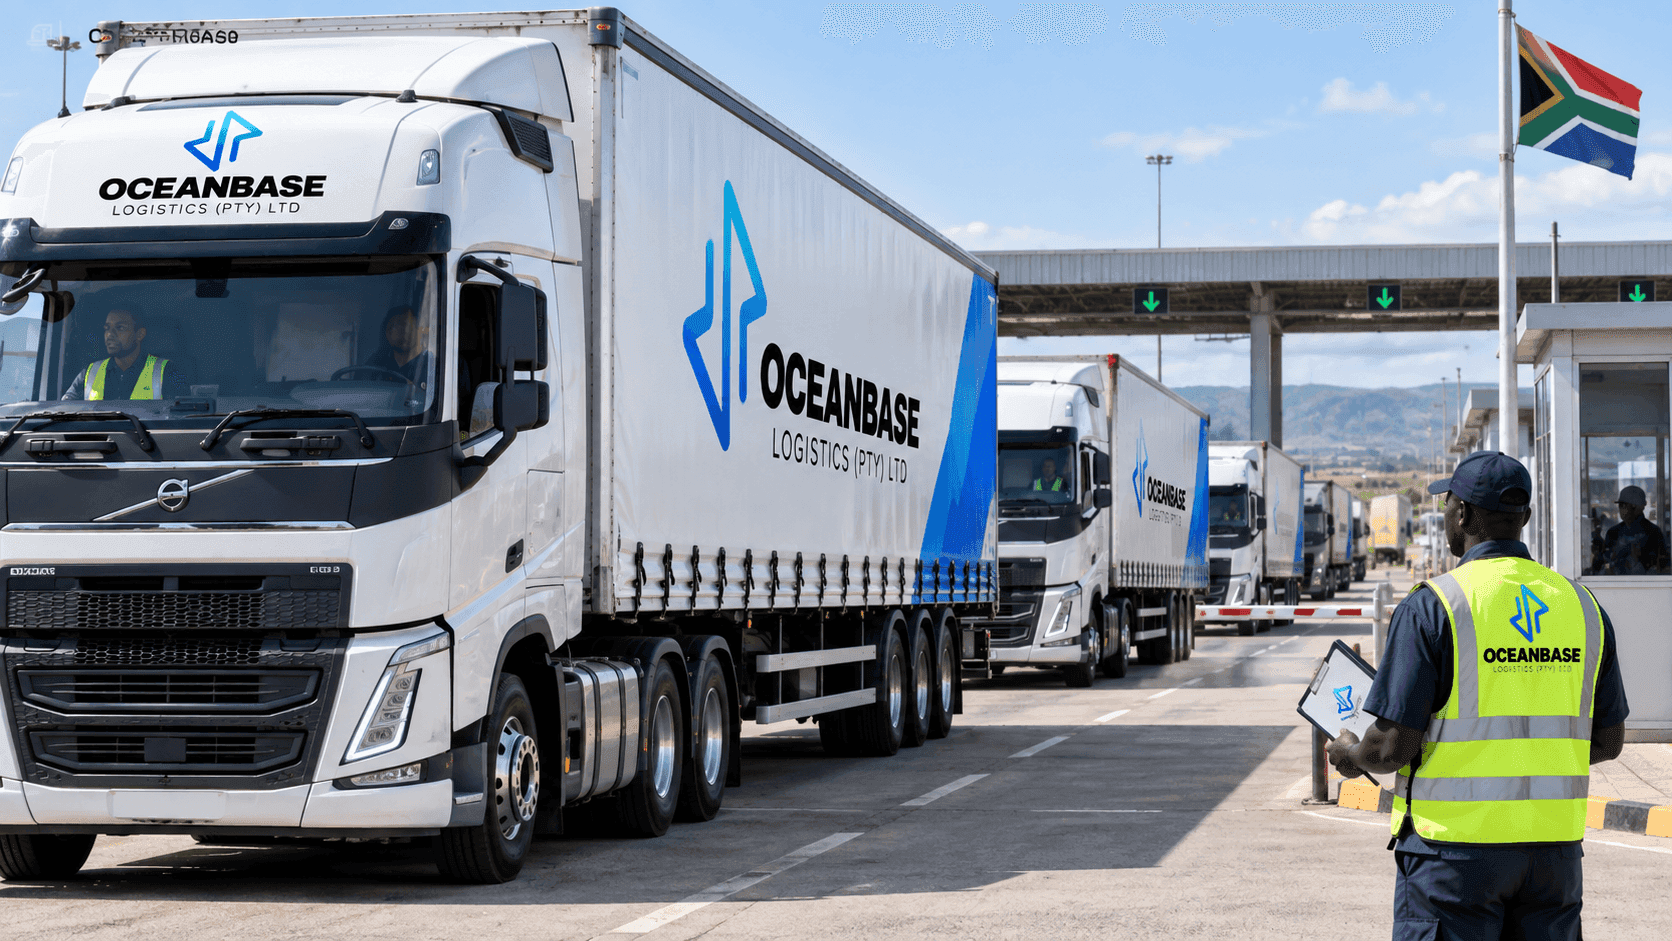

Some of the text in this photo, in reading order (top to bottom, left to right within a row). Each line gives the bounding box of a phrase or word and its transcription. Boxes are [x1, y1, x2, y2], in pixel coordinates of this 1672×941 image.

[99, 175, 327, 200] OCEANBASE
[112, 202, 301, 216] LOGISTICS (PTY) LTD
[760, 342, 920, 449] OCEANBASE
[772, 427, 908, 484] LOGISTICS (PTY) LTD
[1147, 476, 1186, 511] OCEANBASE
[1483, 647, 1581, 663] OCEANBASE
